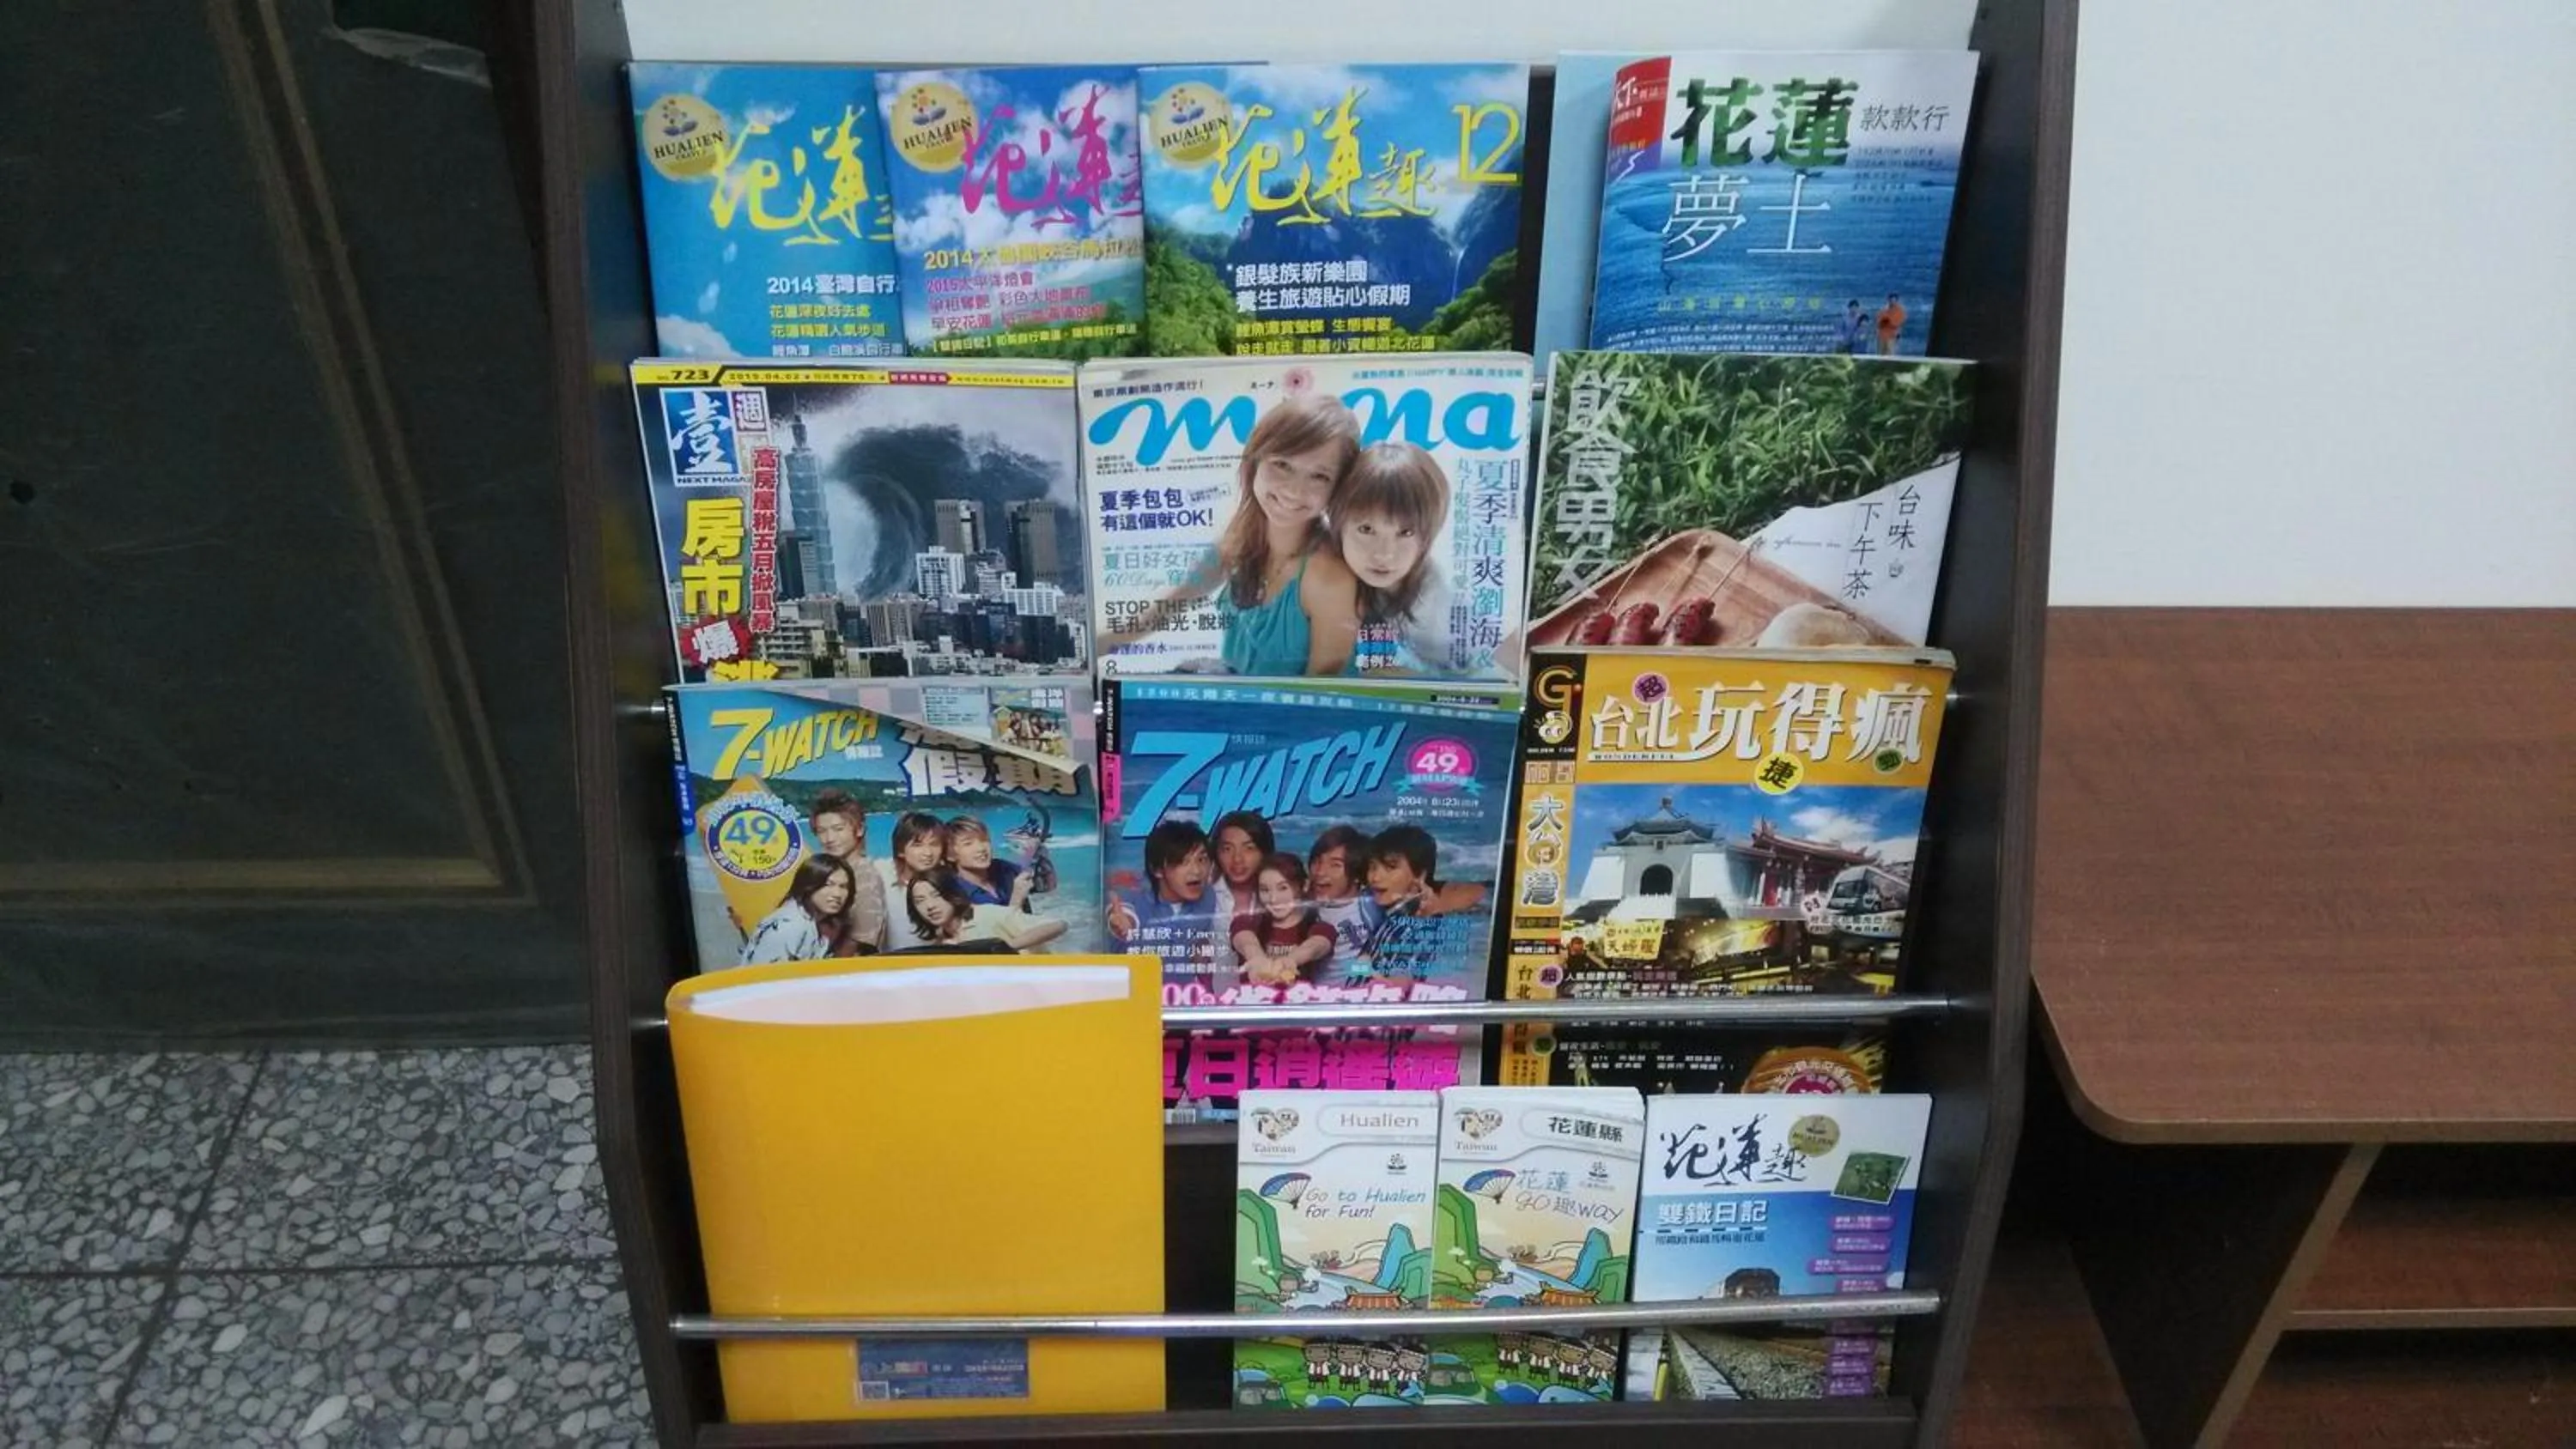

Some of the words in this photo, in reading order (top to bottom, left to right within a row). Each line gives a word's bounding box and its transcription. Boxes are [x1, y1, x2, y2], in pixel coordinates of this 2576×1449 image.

[903, 117, 971, 149] HUALIEN
[1161, 115, 1227, 148] HUALIEN
[1671, 78, 1860, 167] 花蓮
[1860, 104, 1950, 132] 款款行
[654, 130, 723, 158] HUALIEN
[1452, 104, 1521, 186] 12
[1662, 173, 1832, 261] 夢土
[1236, 260, 1368, 288] 銀髮族新樂園
[1236, 284, 1411, 312] 養生旅遊貼心假期
[671, 370, 709, 380] 723
[735, 391, 765, 429] 週
[671, 389, 733, 473] 壹
[1089, 386, 1521, 466] mna
[1099, 488, 1183, 512] 夏季包包
[1552, 369, 1639, 601] 飲食男女
[1889, 484, 1920, 549] 台味
[681, 497, 744, 615] 房市
[1844, 502, 1883, 598] 下午茶
[1105, 600, 1150, 615] STOP
[1154, 598, 1187, 614] THE
[710, 707, 880, 780] 7-WATCH
[1416, 752, 1459, 773] 49
[1758, 757, 1799, 790] 捷
[1121, 722, 1406, 838] 7-WATCH
[725, 815, 777, 845] 49
[1340, 1113, 1419, 1127] Hualien
[1548, 1116, 1624, 1143] 花蓮縣
[1305, 1187, 1330, 1202] Go
[1338, 1188, 1358, 1202] to
[1365, 1187, 1426, 1203] Hualien
[1516, 1168, 1571, 1193] 花蓮
[1304, 1204, 1331, 1218] for
[1338, 1203, 1376, 1219] Fun!
[1658, 1200, 1767, 1226] 雙鐵日記
